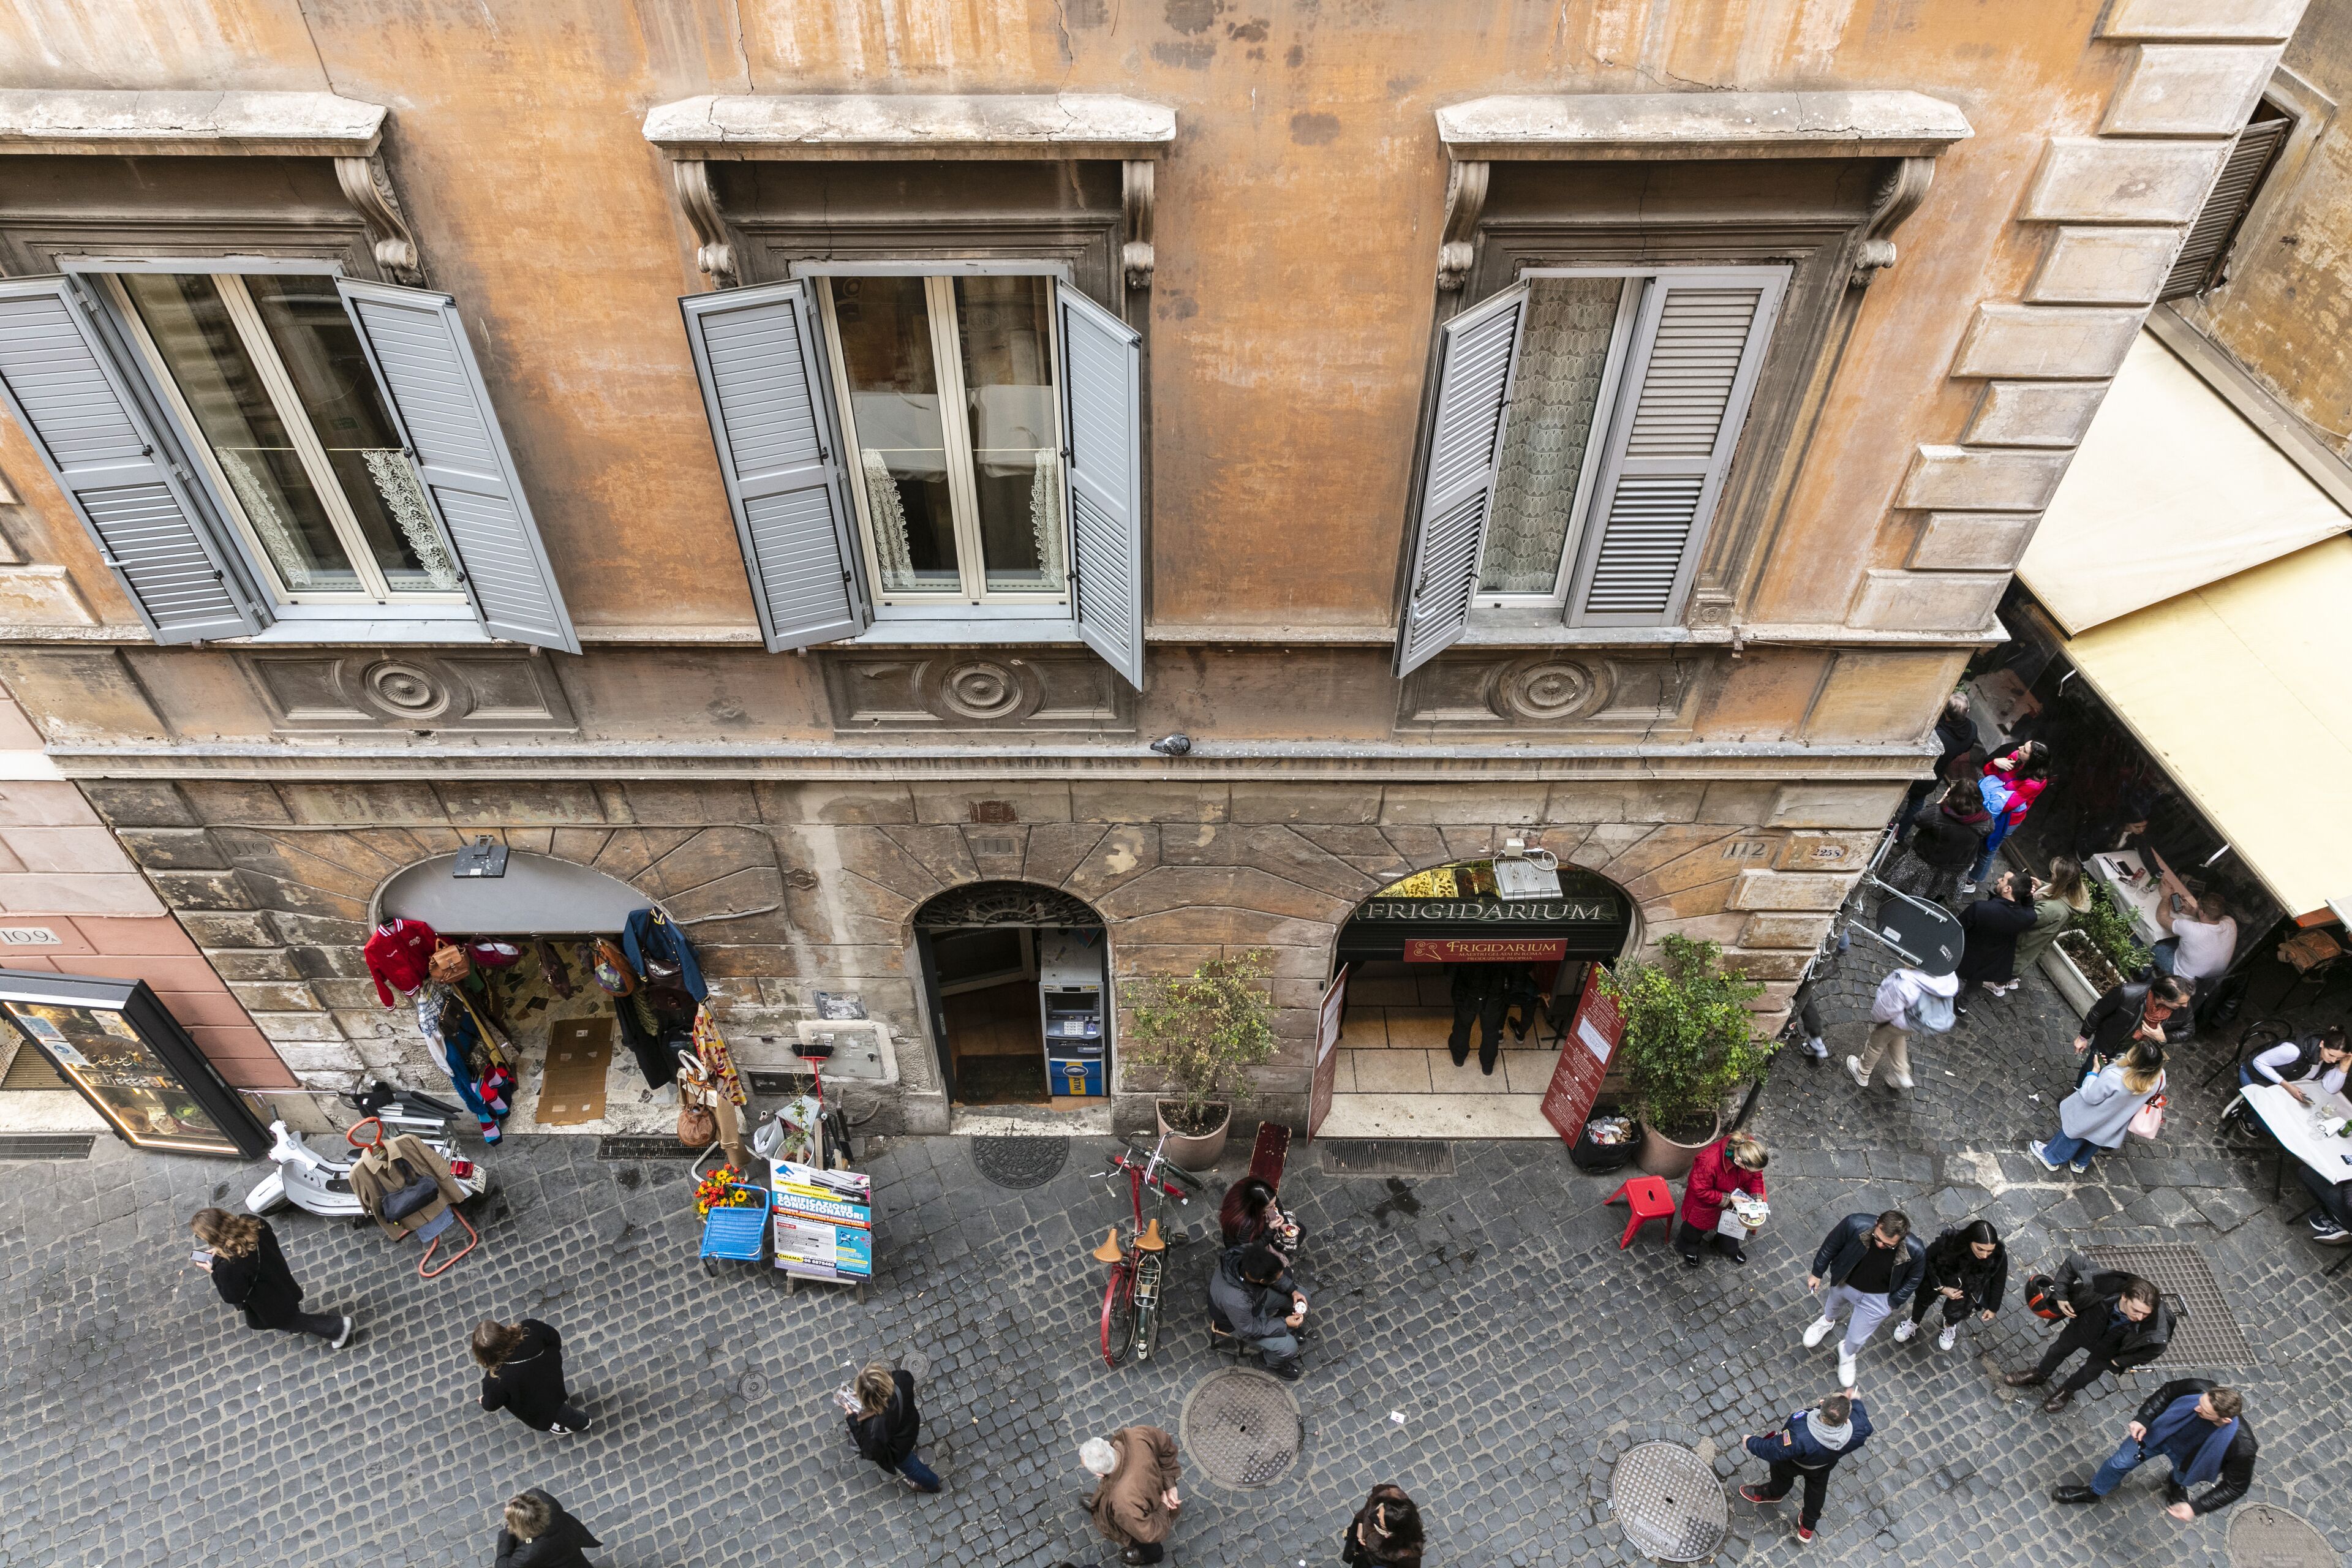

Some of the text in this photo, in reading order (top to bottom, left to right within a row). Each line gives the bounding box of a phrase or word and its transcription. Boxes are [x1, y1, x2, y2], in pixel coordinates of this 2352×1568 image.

[1730, 843, 1765, 856] 112
[1366, 903, 1600, 919] FRIGIDARIUM
[1, 930, 48, 942] 109
[1446, 941, 1556, 952] FRIGIDARIUM
[777, 1193, 853, 1212] SANIFICAZIONE
[777, 1199, 863, 1220] CONDIZIONATORI
[1641, 1519, 1671, 1542] ACEA
